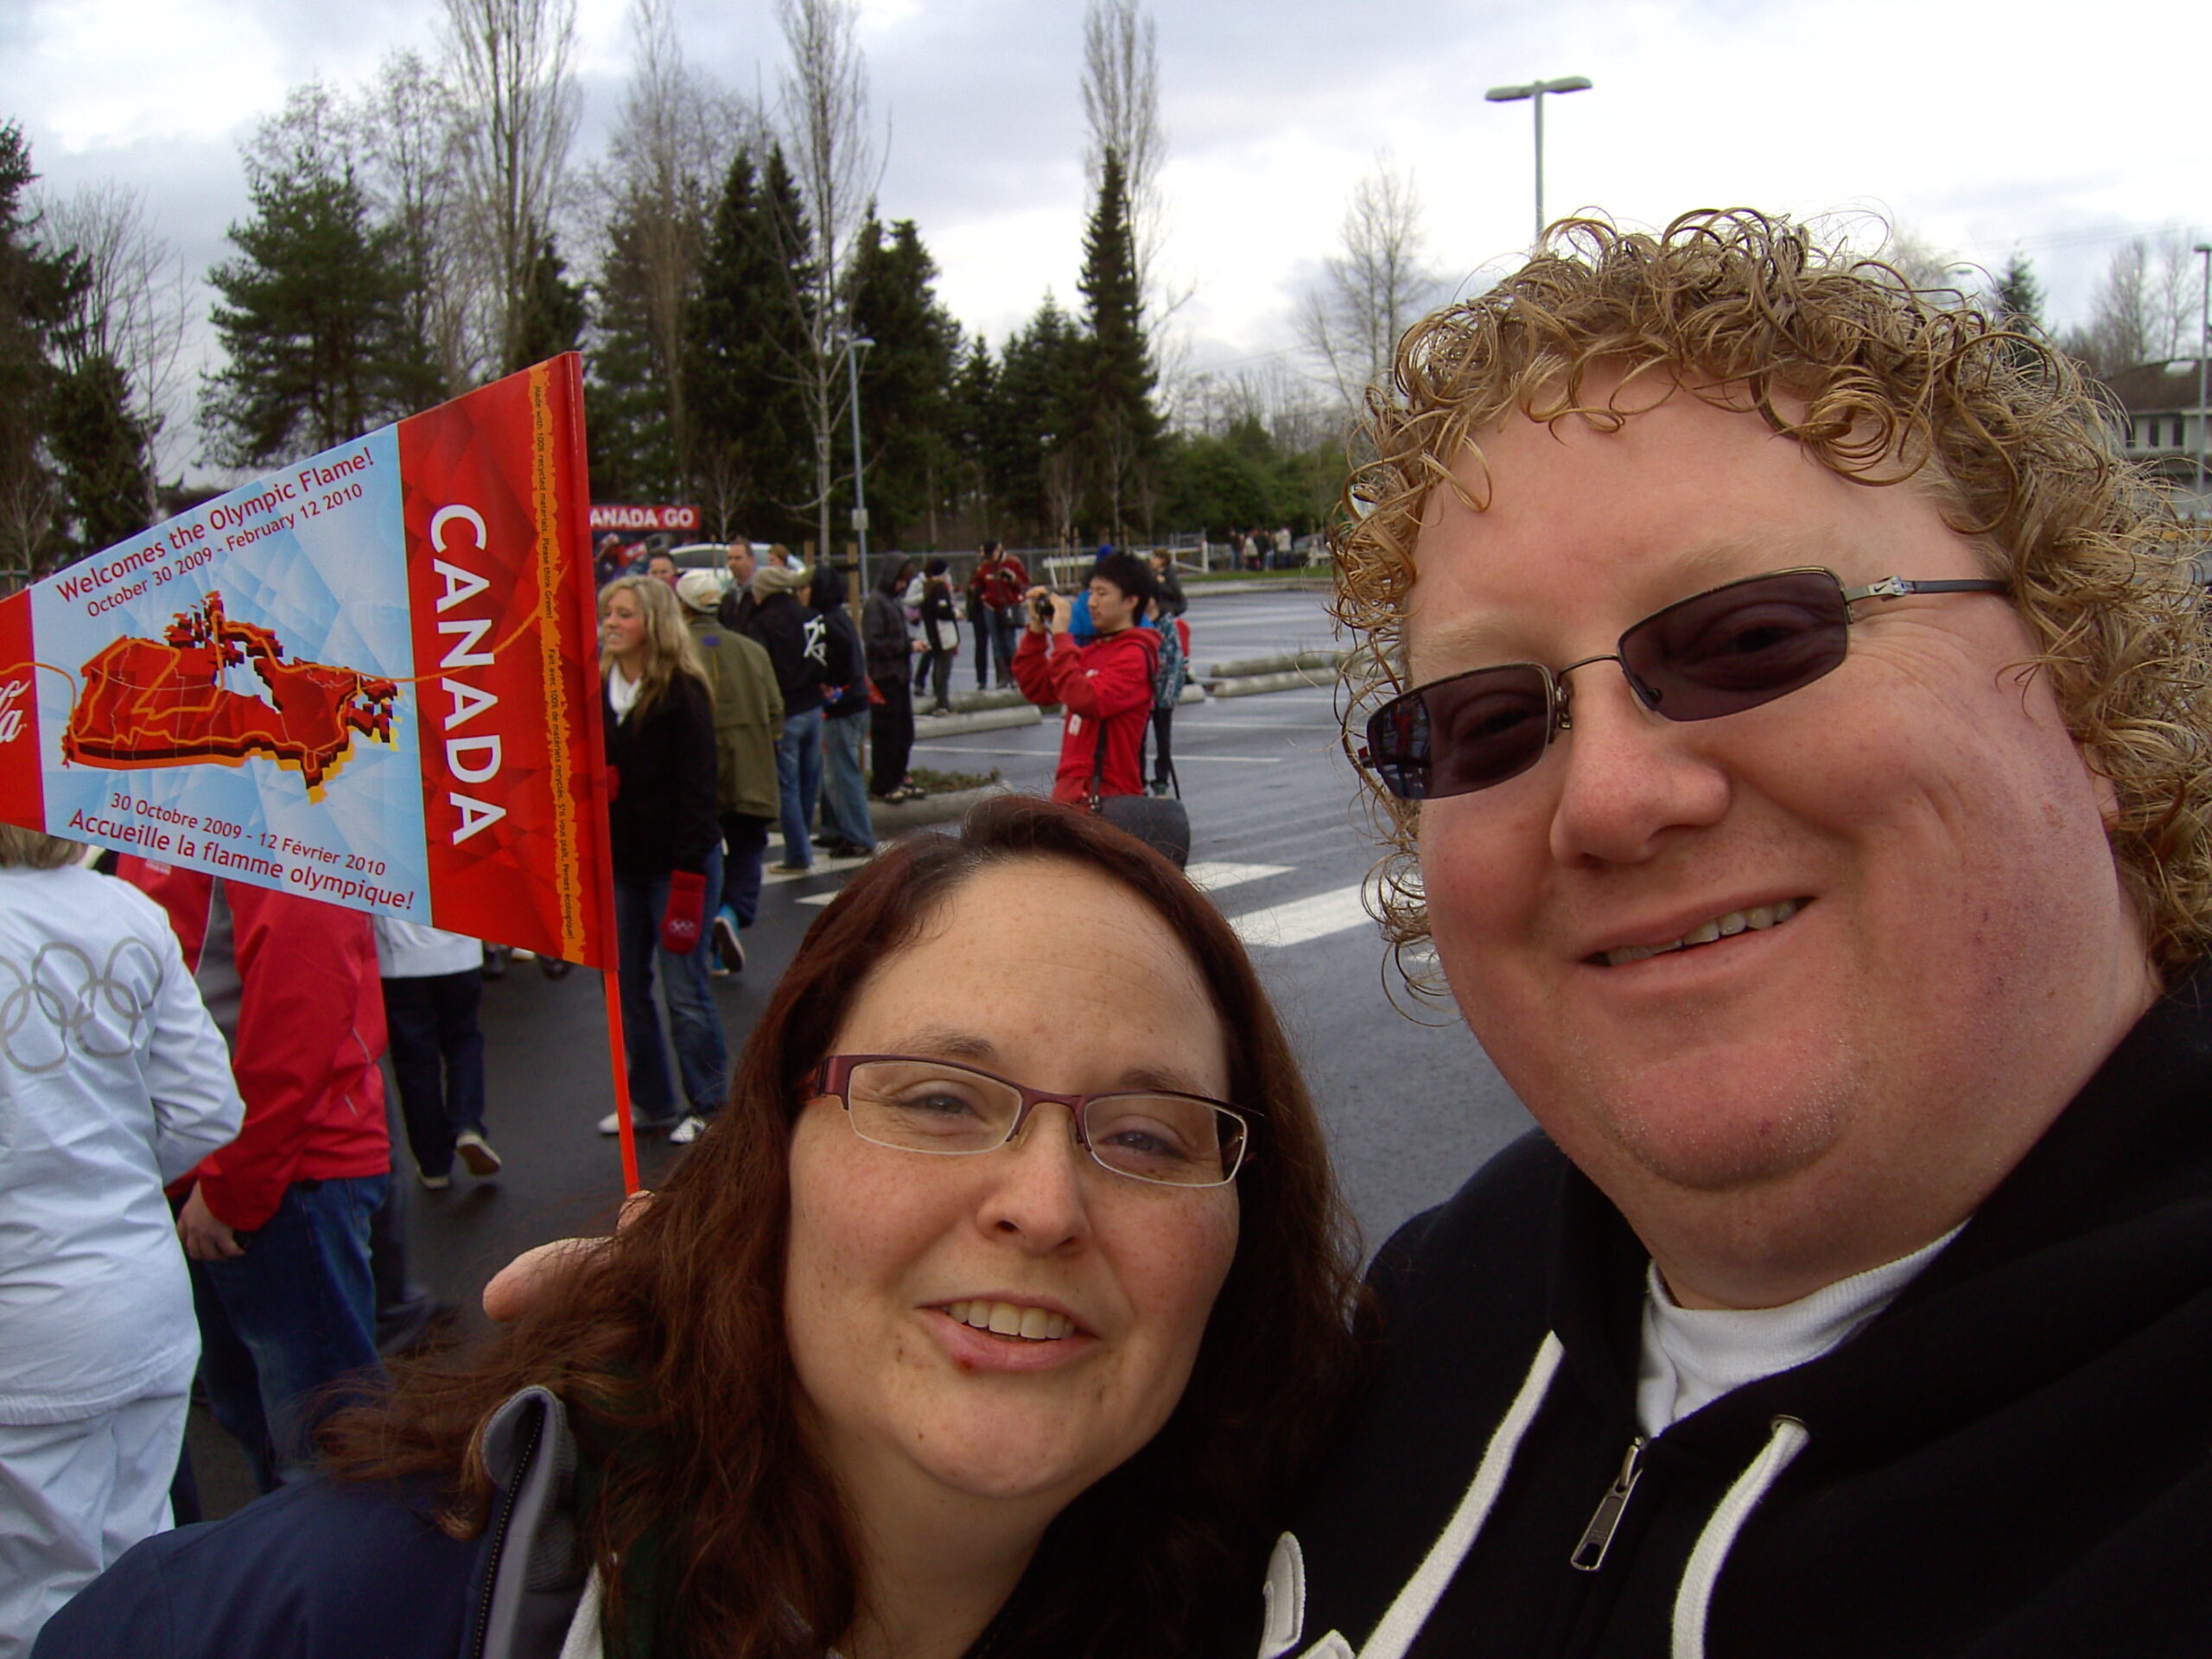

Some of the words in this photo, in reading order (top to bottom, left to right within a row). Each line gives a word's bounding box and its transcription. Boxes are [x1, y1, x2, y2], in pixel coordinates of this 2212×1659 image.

[537, 454, 546, 491] recycled
[55, 541, 166, 603] Welcomes
[168, 519, 206, 550] the
[209, 481, 296, 531] Olympic
[297, 447, 374, 493] Flame!
[590, 508, 658, 527] ANADA
[664, 507, 694, 527] GO
[87, 577, 149, 618] October
[153, 566, 173, 587] 30
[175, 547, 213, 577] 2009
[226, 513, 296, 552] February
[301, 500, 321, 518] 12
[322, 484, 363, 510] 2010
[542, 537, 550, 565] Please
[544, 590, 553, 619] Green!
[430, 504, 507, 845] CANADA
[552, 711, 559, 721] de
[68, 808, 170, 850] Accueille
[176, 834, 195, 858] la
[202, 841, 283, 879] flamme
[289, 867, 415, 912] olympique!
[111, 793, 131, 810] 30
[136, 800, 198, 828] Octobre
[202, 817, 242, 839] 2009
[259, 832, 277, 849] 12
[282, 837, 341, 864] Février
[345, 854, 385, 876] 2010
